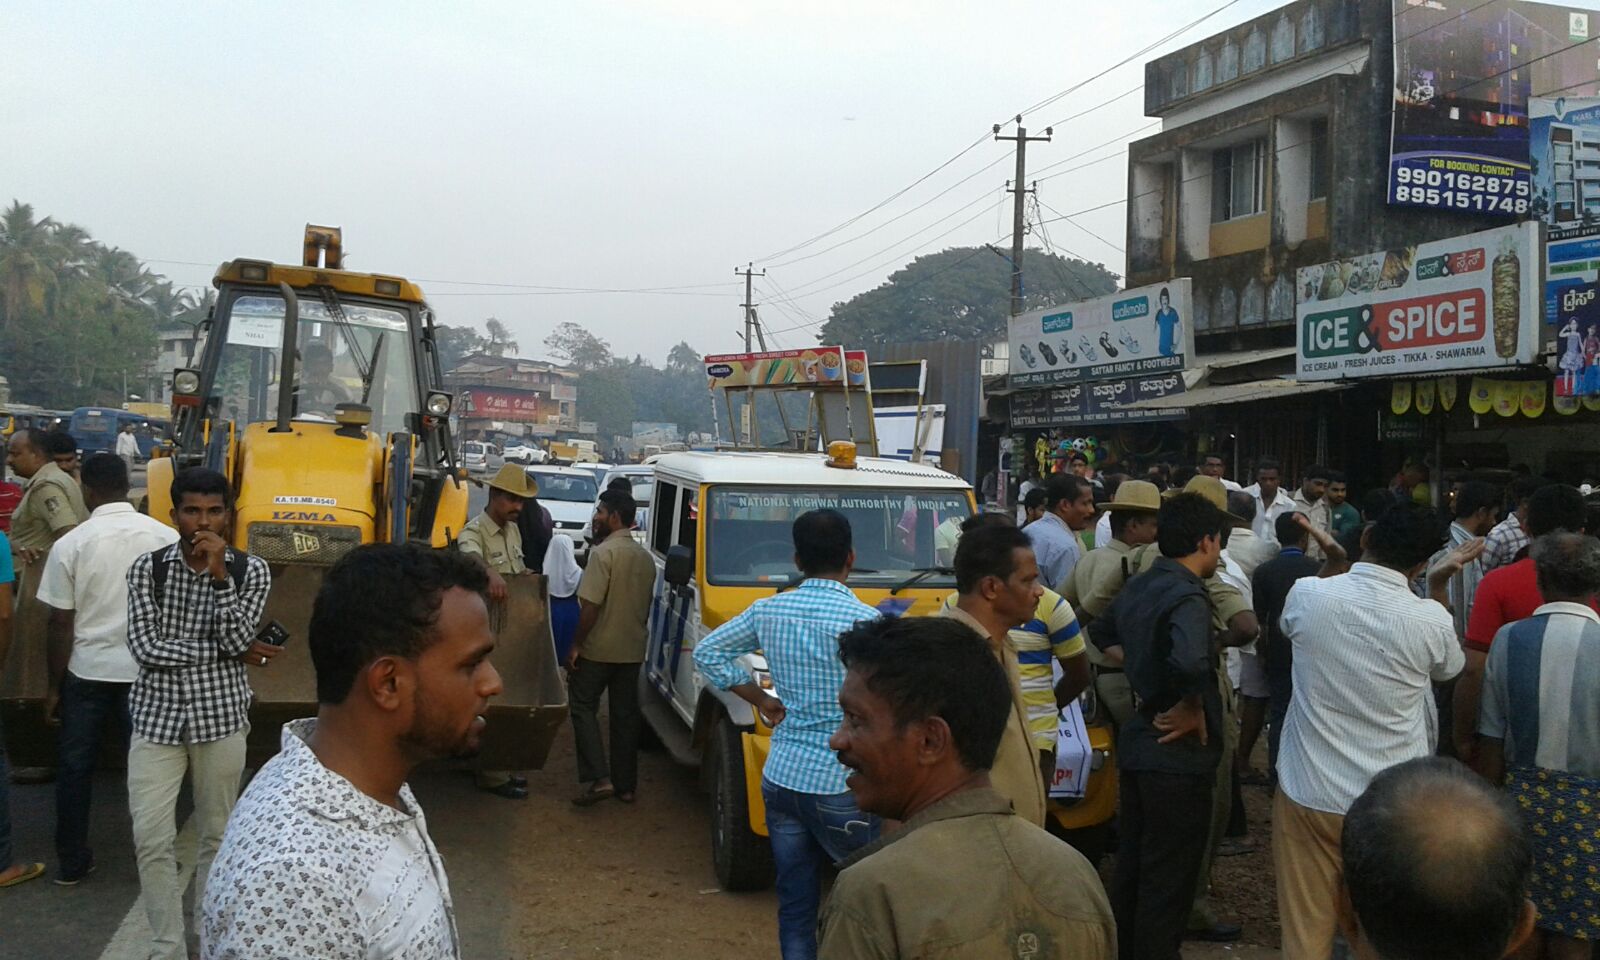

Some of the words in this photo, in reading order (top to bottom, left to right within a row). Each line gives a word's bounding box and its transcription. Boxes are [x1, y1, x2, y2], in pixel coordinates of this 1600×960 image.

[1430, 158, 1445, 169] FOR
[1446, 161, 1480, 173] BOOKING
[1481, 164, 1514, 176] CONTACT
[1397, 167, 1529, 196] 990162875
[1396, 185, 1531, 214] 895151748
[1379, 279, 1398, 289] GRILL
[1308, 316, 1349, 351] ICE
[1355, 304, 1383, 353] &
[1387, 298, 1476, 343] SPICE
[1091, 365, 1114, 376] SATTAR
[1115, 361, 1135, 372] FANCY
[1136, 360, 1142, 370] &
[1142, 355, 1180, 369] FOOTWEAR
[1302, 363, 1313, 373] ICE
[1314, 360, 1338, 372] CREAM
[1344, 359, 1367, 368] FRESH
[1369, 355, 1396, 367] JUICES
[1403, 351, 1428, 363] TIKKA
[1435, 346, 1486, 360] SHAWARMA
[1092, 380, 1127, 400] ಸತ್ತಾರ್
[1139, 375, 1178, 396] ಸತ್ತಾರ್
[1013, 415, 1036, 426] SATTAR
[739, 496, 791, 508] NATIONAL
[792, 497, 839, 509] HIGHWAY
[917, 500, 946, 512] INDIA
[271, 511, 337, 522] IZMA
[294, 533, 319, 553] JCB
